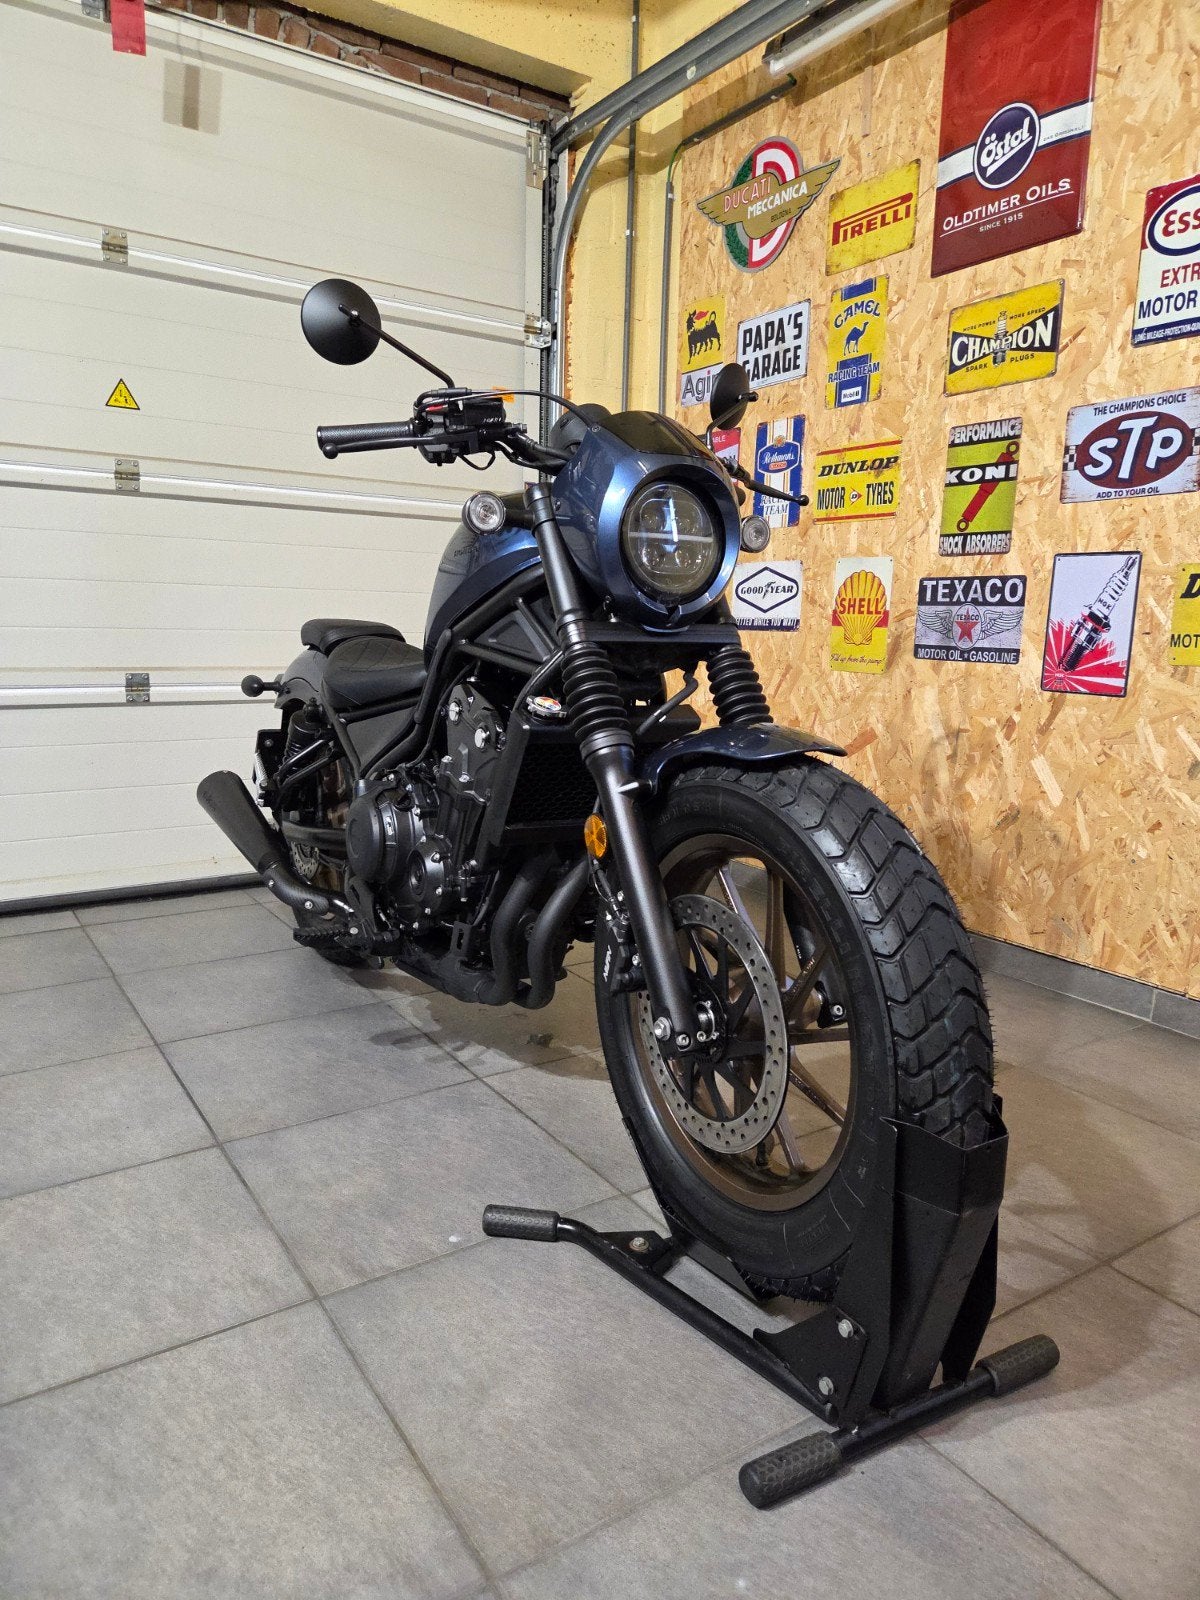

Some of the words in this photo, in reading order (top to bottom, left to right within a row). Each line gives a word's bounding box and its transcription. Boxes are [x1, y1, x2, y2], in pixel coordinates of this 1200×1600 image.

[980, 117, 1032, 169] Östal
[724, 177, 771, 212] DUCATI
[748, 181, 808, 219] MECCANICA
[943, 194, 1020, 231] OLDTIMER
[1026, 178, 1071, 201] OILS
[832, 192, 914, 246] PIRELLI
[979, 220, 1001, 232] SINCE
[1003, 212, 1024, 224] 1915
[834, 299, 881, 328] CAMEL
[1138, 289, 1198, 320] MOTOR
[978, 320, 996, 330] POWER
[1009, 312, 1025, 320] MORE
[1027, 307, 1046, 316] SPEED
[742, 311, 803, 355] PAPA'S
[952, 311, 1054, 367] CHAMPION
[828, 367, 857, 383] RACING
[858, 362, 880, 376] TEAM
[965, 363, 988, 373] SPARK
[1010, 353, 1035, 363] PLUGS
[1093, 406, 1109, 416] THE
[1109, 398, 1155, 414] CHAMPIONS
[1156, 393, 1187, 406] CHOICE
[950, 418, 1022, 445] PERFORMANCE
[1083, 416, 1183, 480] STP
[818, 456, 899, 477] DUNLOP
[945, 463, 1018, 484] KONI
[817, 487, 846, 510] MOTOR
[866, 481, 894, 506] TYRES
[1096, 491, 1112, 499] ADD
[1113, 490, 1124, 498] TO
[1125, 488, 1147, 497] YOUR
[1147, 486, 1160, 495] OIL
[765, 504, 789, 515] TEAM
[940, 535, 963, 554] SHOCK
[965, 533, 1012, 553] ABSORBERS
[922, 578, 1024, 603] TEXACO
[839, 597, 883, 615] SHELL
[917, 648, 947, 659] MOTOR
[948, 649, 963, 660] OIL
[969, 651, 1017, 663] GASOLINE
